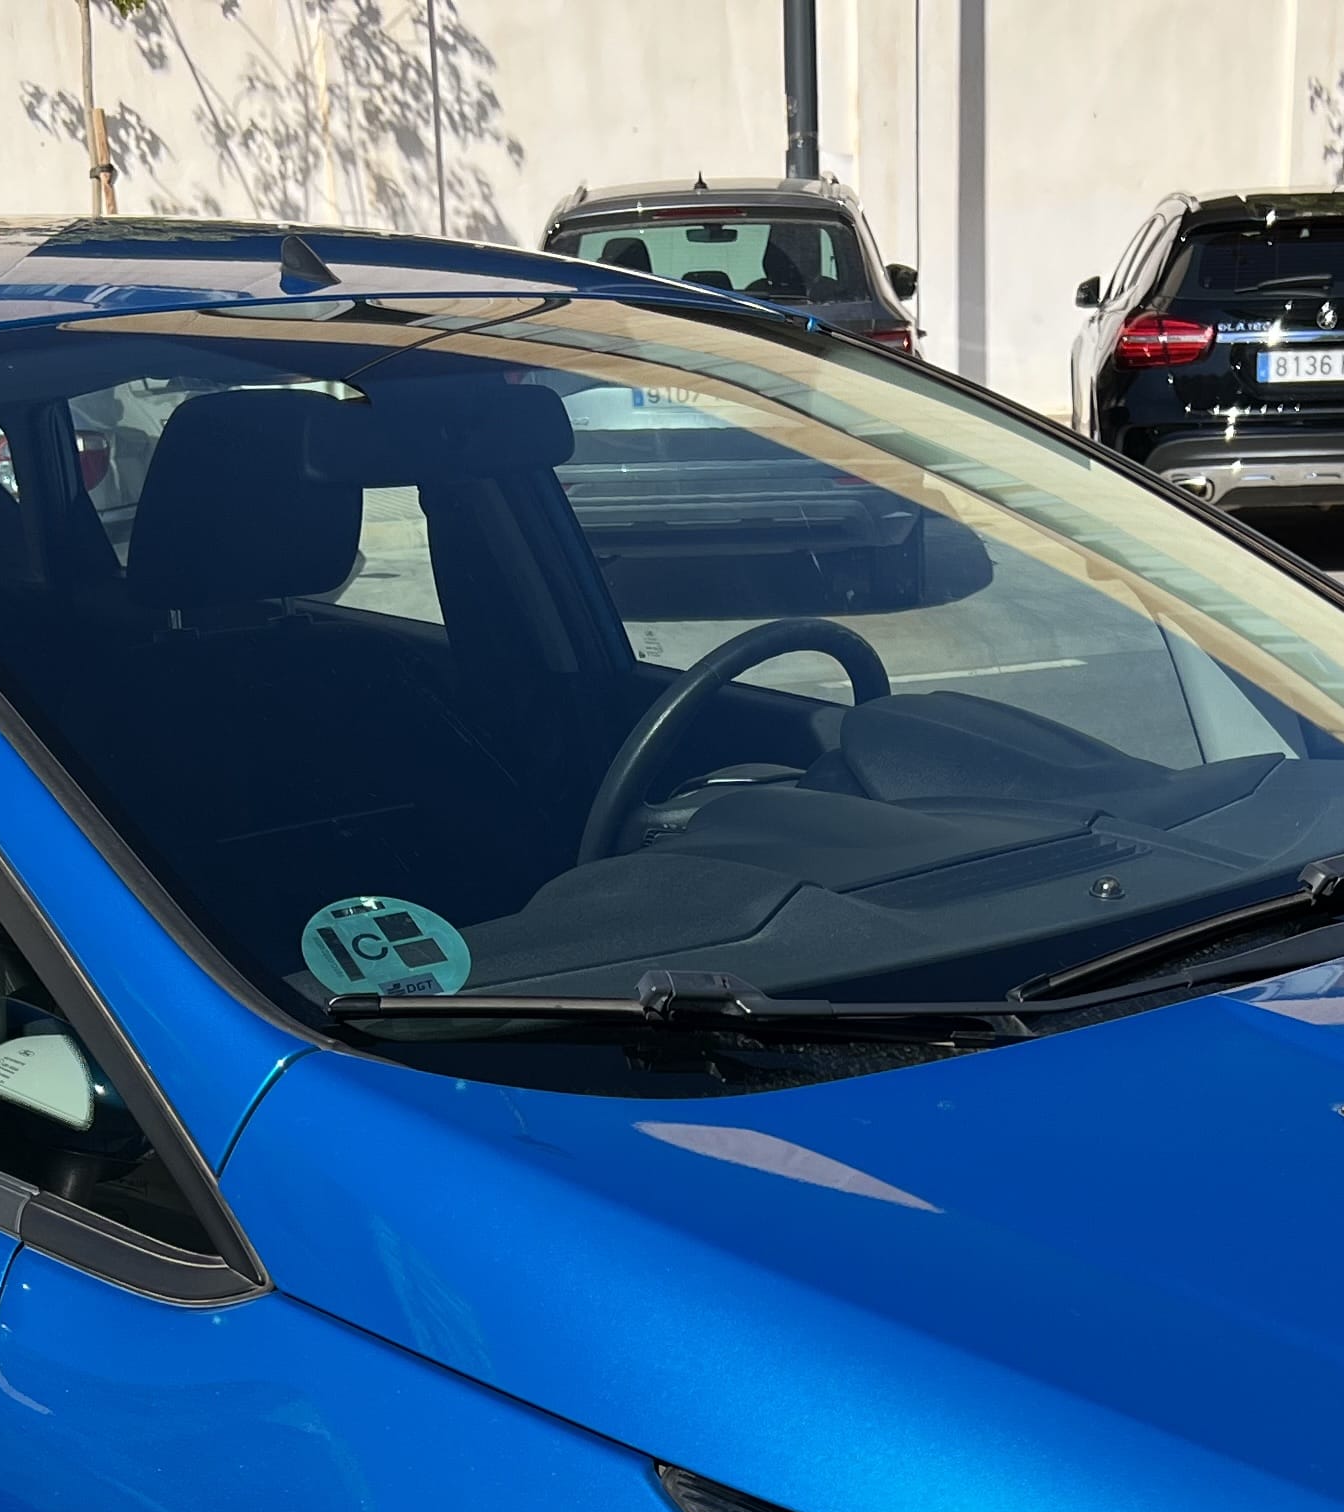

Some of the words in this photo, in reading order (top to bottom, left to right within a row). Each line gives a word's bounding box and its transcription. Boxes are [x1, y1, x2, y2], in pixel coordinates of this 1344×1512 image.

[1276, 355, 1333, 377] 8136
[351, 933, 389, 961] C
[406, 979, 434, 994] DGT
